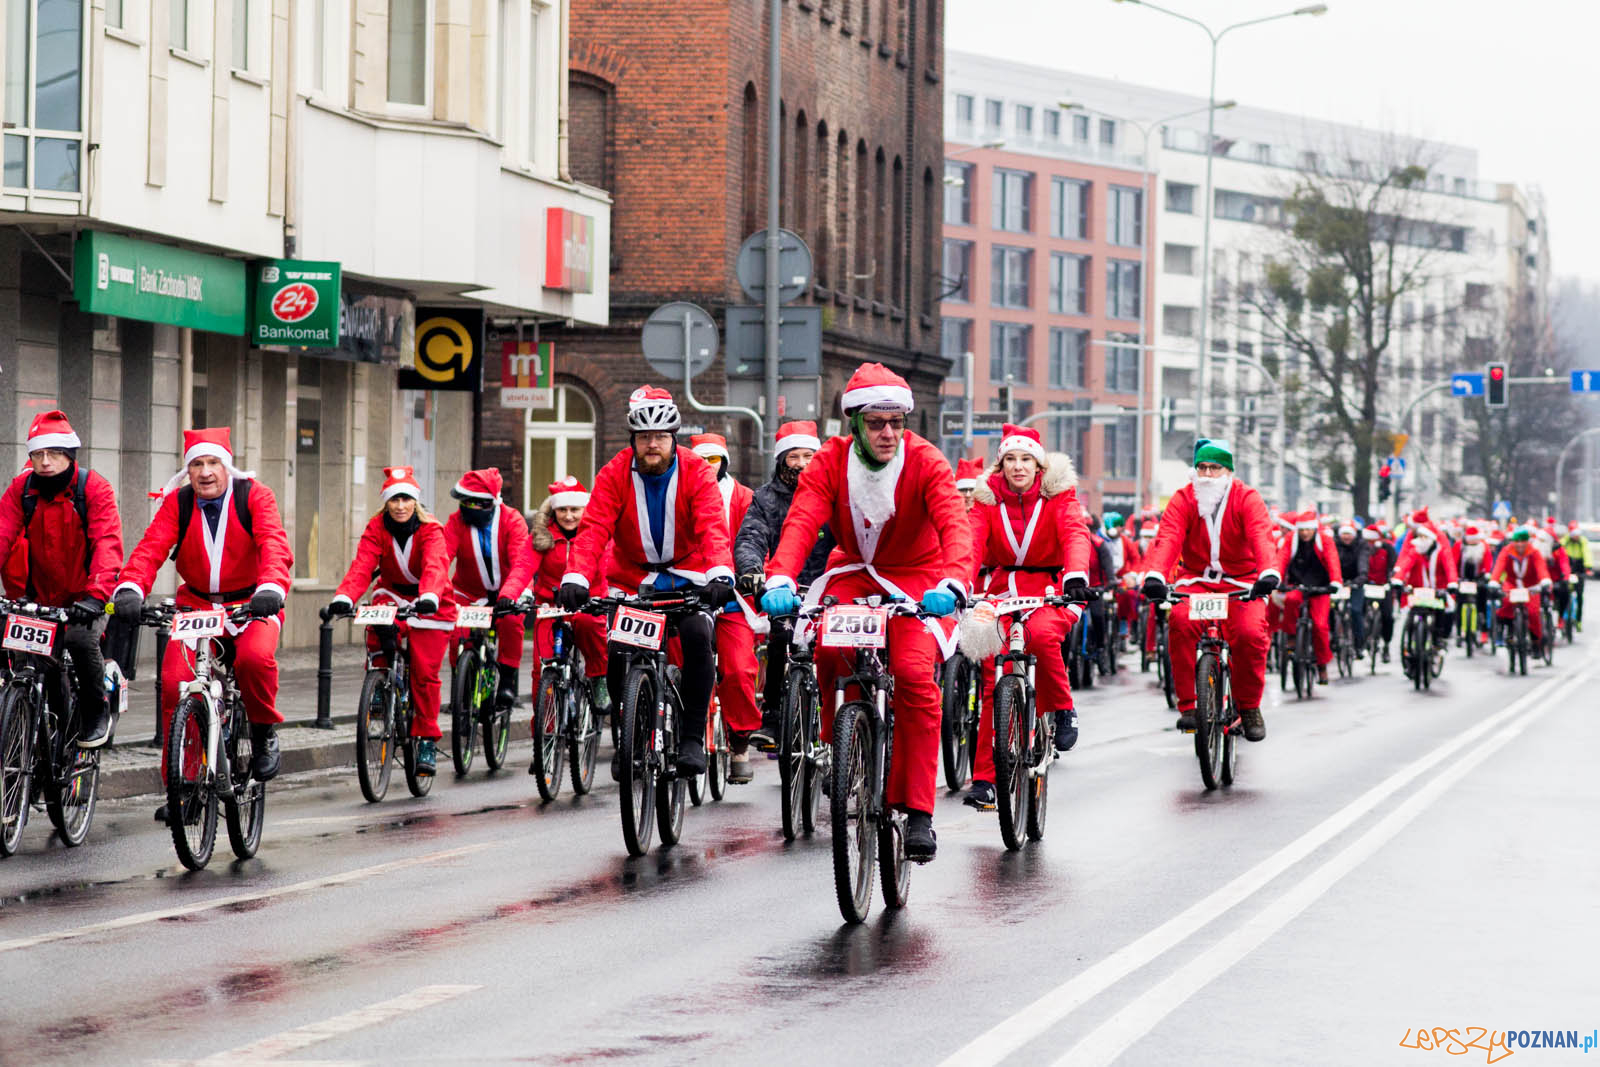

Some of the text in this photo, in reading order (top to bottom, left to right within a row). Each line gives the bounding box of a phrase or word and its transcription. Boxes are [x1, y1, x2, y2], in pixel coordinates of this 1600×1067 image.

[141, 265, 158, 293] Bank
[279, 291, 307, 311] 24
[259, 324, 329, 339] Bankomat
[509, 354, 543, 376] m
[1195, 600, 1222, 611] 001
[178, 616, 218, 631] 200
[620, 616, 656, 637] 070
[829, 615, 877, 634] 250
[10, 624, 49, 644] 035
